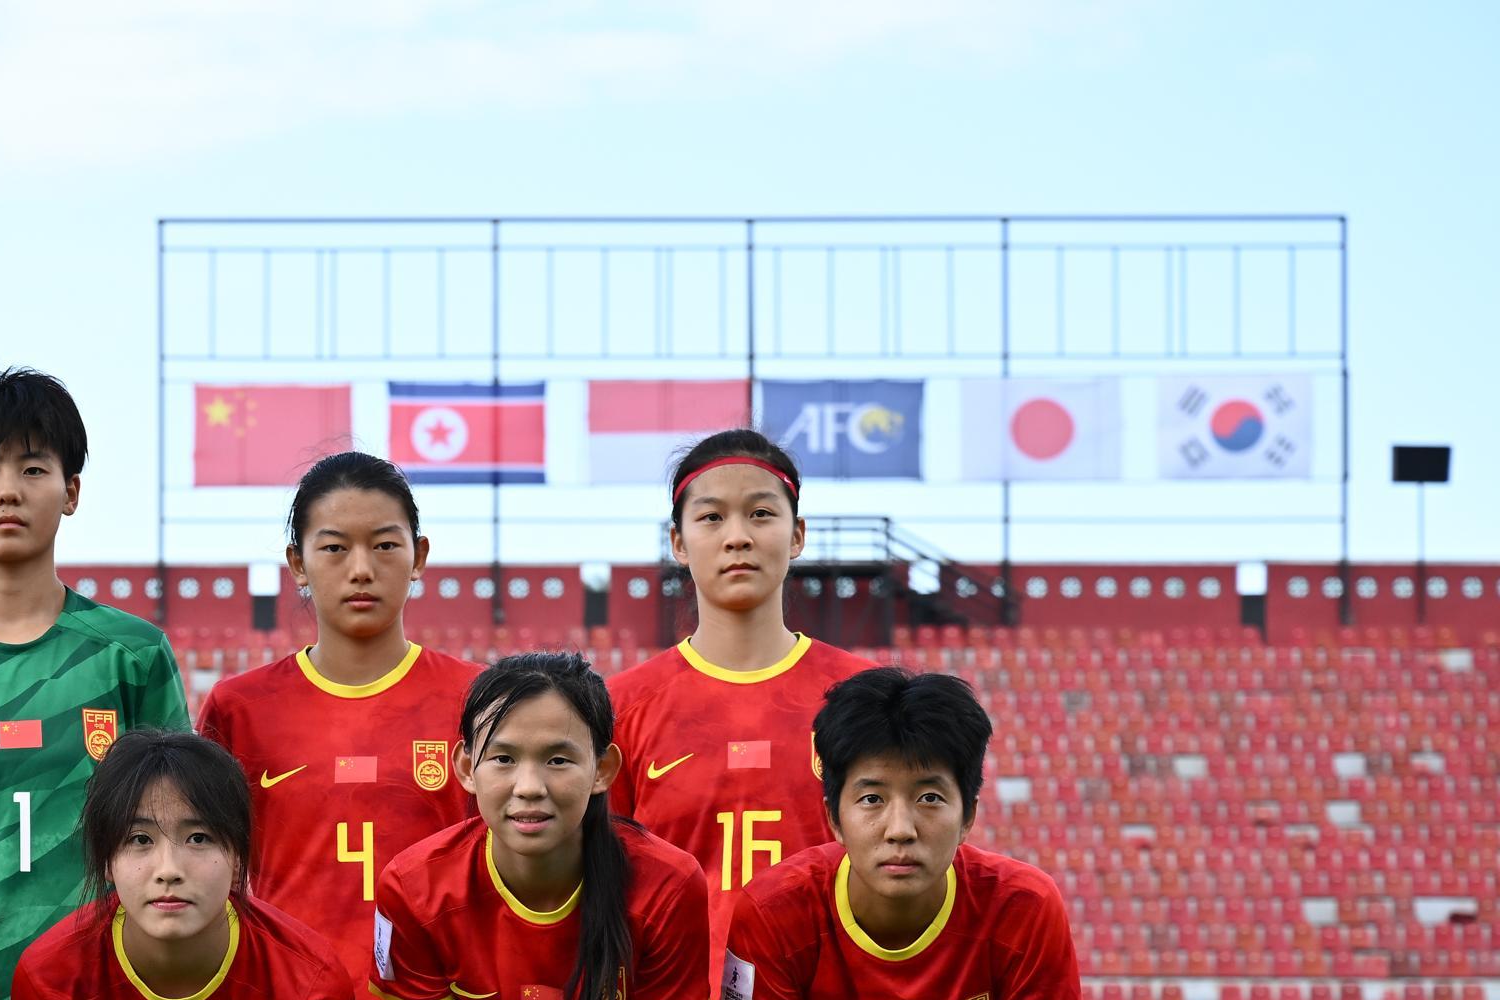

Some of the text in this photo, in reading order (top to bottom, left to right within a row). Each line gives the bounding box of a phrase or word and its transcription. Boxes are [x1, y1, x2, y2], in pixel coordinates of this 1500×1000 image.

[778, 402, 900, 454] AFC
[86, 713, 113, 723] CFA
[416, 744, 445, 753] CFA
[14, 792, 30, 871] 1
[337, 822, 374, 901] 4
[717, 810, 781, 890] 16
